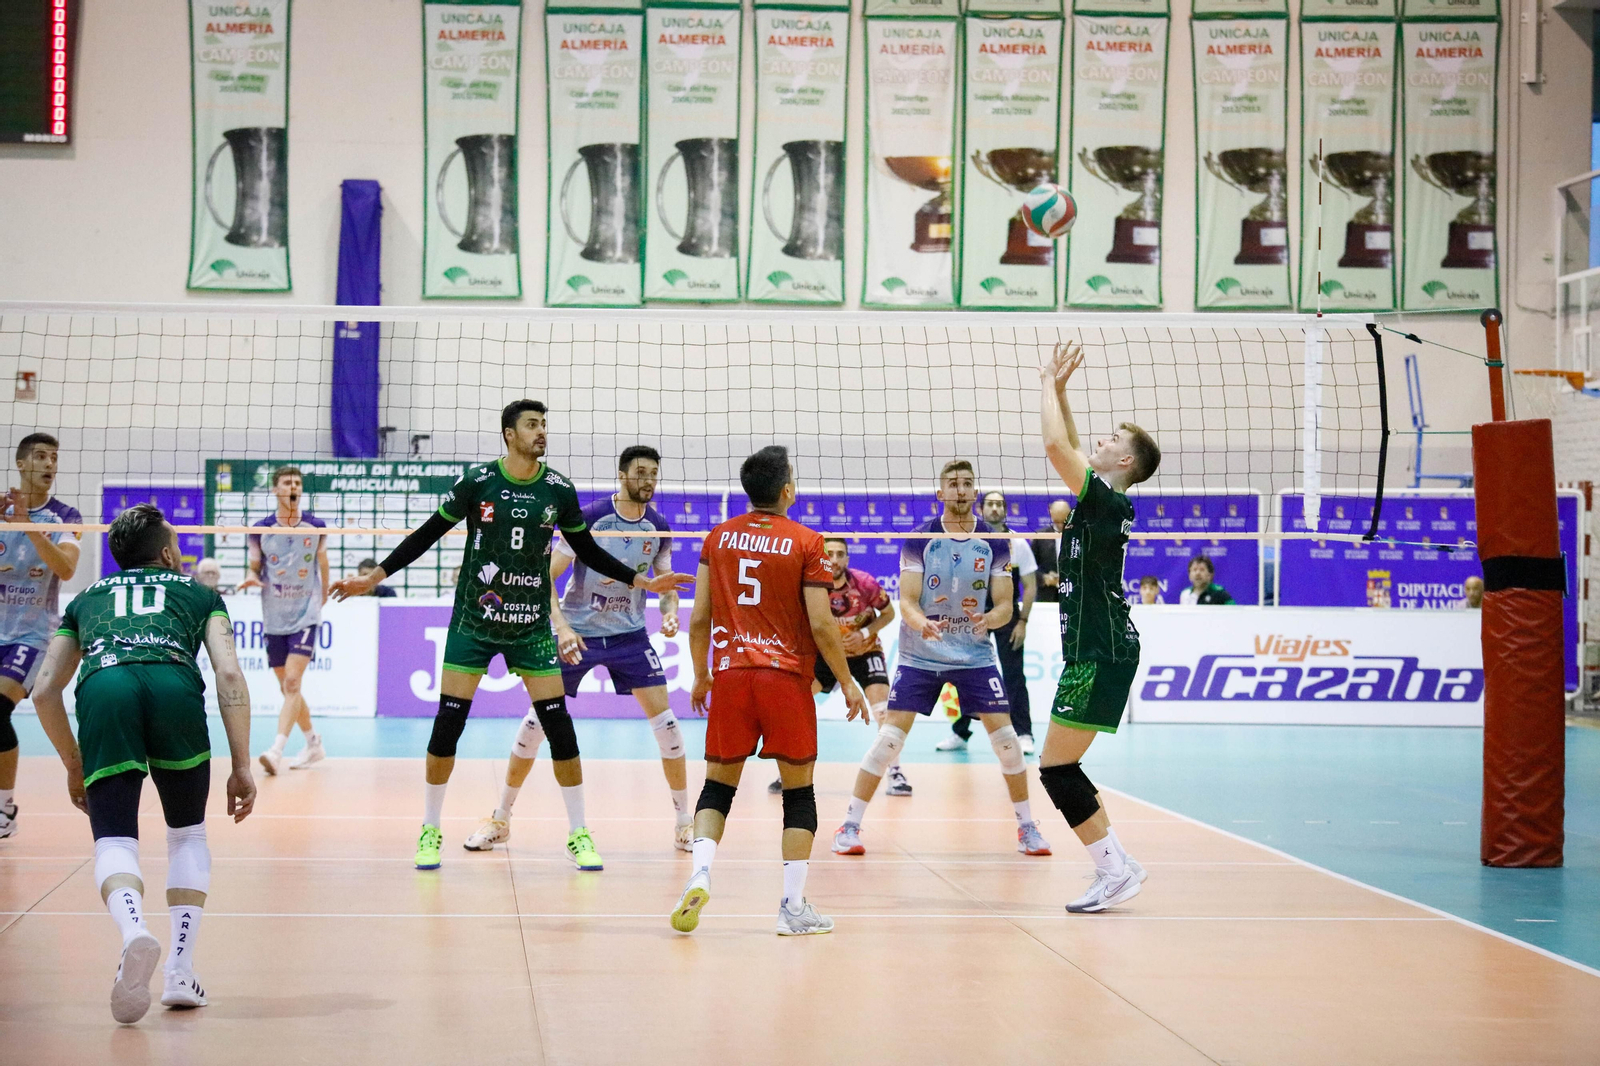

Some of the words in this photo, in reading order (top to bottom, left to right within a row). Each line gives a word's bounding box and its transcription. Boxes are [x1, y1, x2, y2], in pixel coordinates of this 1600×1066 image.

[53, 9, 66, 21] 0
[209, 6, 271, 17] UNICAJA
[441, 13, 503, 24] UNICAJA
[662, 18, 724, 28] UNICAJA
[772, 18, 832, 31] UNICAJA
[53, 22, 66, 35] 0
[563, 23, 625, 34] UNICAJA
[882, 28, 941, 39] UNICAJA
[982, 27, 1044, 39] UNICAJA
[1089, 24, 1150, 36] UNICAJA
[1210, 28, 1270, 40] UNICAJA
[1318, 30, 1378, 42] UNICAJA
[1420, 30, 1480, 42] UNICAJA
[53, 37, 66, 49] 0
[53, 51, 66, 64] 0
[53, 65, 66, 78] 0
[53, 79, 66, 92] 0
[53, 93, 66, 106] 0
[53, 107, 66, 120] 0
[53, 121, 66, 134] 0
[236, 270, 270, 280] Unicaja
[468, 276, 502, 286] Unicaja
[592, 286, 626, 295] Unicaja
[688, 280, 720, 290] Unicaja
[792, 282, 826, 292] Unicaja
[905, 286, 938, 296] Unicaja
[1110, 286, 1144, 296] Unicaja
[1004, 286, 1038, 298] Unicaja
[1240, 286, 1274, 298] Unicaja
[1343, 290, 1376, 300] Unicaja
[1446, 288, 1480, 300] Unicaja
[371, 464, 393, 476] DE
[397, 464, 464, 477] VOLEIBOL
[330, 478, 420, 491] MASCULINA
[510, 526, 524, 550] 8
[718, 532, 793, 556] PAQUILLO
[145, 574, 192, 586] RUIZ
[737, 558, 762, 606] 5
[952, 576, 958, 593] 9
[8, 585, 36, 595] Grupo
[1398, 582, 1464, 598] DIPUTACI
[8, 594, 43, 606] Herce
[108, 584, 166, 617] 10
[608, 596, 632, 604] Grupo
[504, 602, 531, 612] COSTA
[942, 614, 970, 624] Grupo
[940, 624, 979, 636] Herce
[300, 629, 311, 644] 7
[732, 632, 785, 648] Andalucía
[1254, 634, 1352, 662] Viajes
[15, 646, 30, 666] 5
[644, 650, 660, 669] 6
[866, 656, 884, 672] 10
[1140, 654, 1484, 702] alcazaba
[988, 676, 1004, 698] 9
[122, 892, 140, 923] AR27
[176, 912, 192, 956] AR27
